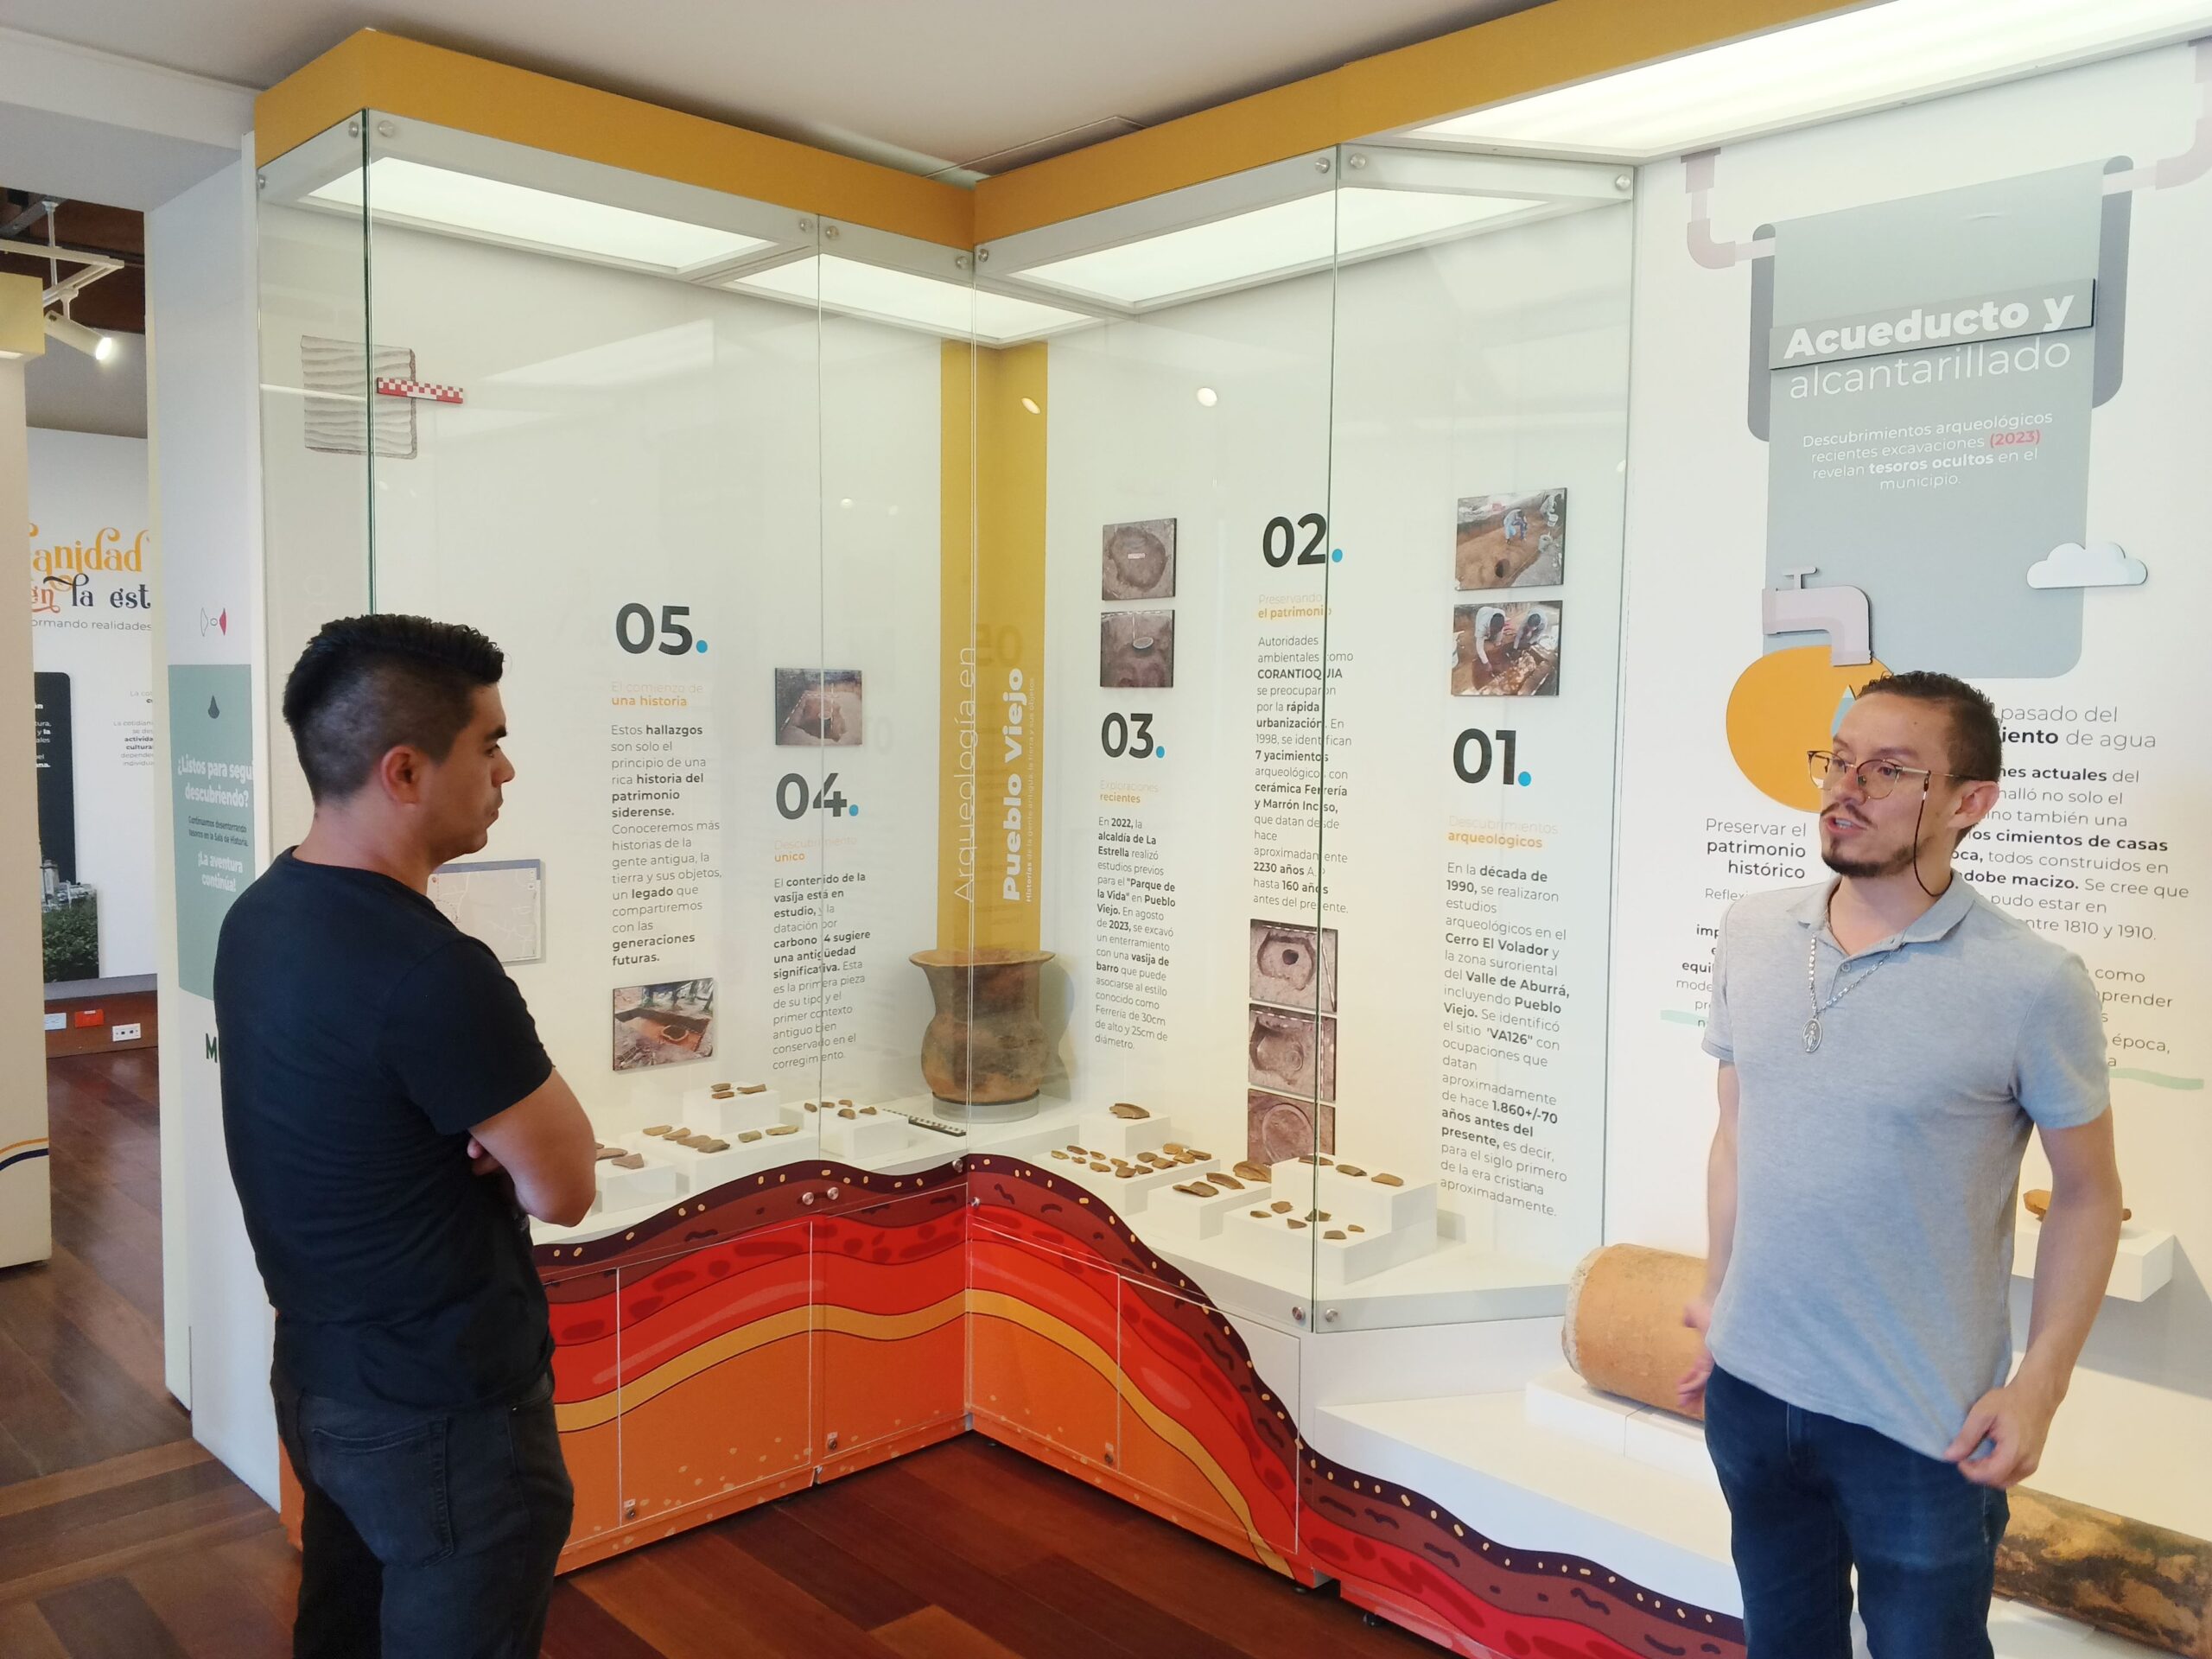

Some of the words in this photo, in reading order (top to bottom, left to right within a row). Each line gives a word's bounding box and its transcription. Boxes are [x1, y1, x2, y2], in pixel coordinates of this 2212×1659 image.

[1784, 305, 2029, 360] Acueducto
[2043, 294, 2075, 332] y
[1789, 336, 2071, 399] alcantarillado
[1803, 425, 1931, 448] Descubrimientos
[1936, 412, 2053, 435] arqueológicos
[1812, 448, 1878, 463] recientes
[1882, 436, 1984, 456] excavaciones
[1990, 429, 2040, 448] (2023)
[1814, 464, 1865, 479] revelan
[1869, 460, 1928, 474] tesoros
[1933, 453, 1994, 468] ocultos
[1999, 450, 2018, 463] en
[2024, 448, 2037, 460] el
[1880, 474, 1961, 490] municipio.
[1258, 636, 1319, 646] Autoridades
[1258, 652, 1319, 663] ambientales
[640, 696, 687, 706] historia
[1257, 702, 1273, 713] por
[1276, 702, 1283, 711] la
[1287, 701, 1319, 714] rápida
[1003, 668, 1027, 763] Viejo
[2000, 705, 2077, 723] pasado
[2084, 707, 2118, 722] del
[612, 725, 643, 734] Estos
[646, 725, 702, 737] hallazgos
[2066, 730, 2093, 746] de
[2100, 734, 2156, 750] agua
[1255, 750, 1261, 760] 7
[208, 762, 227, 779] para
[613, 775, 632, 785] rica
[637, 773, 682, 784] historia
[686, 773, 703, 783] del
[2031, 768, 2107, 781] actuales
[2113, 770, 2139, 782] del
[185, 783, 248, 807] descubriendo?
[612, 789, 680, 804] patrimonio
[1255, 783, 1301, 793] cerámica
[1100, 792, 1141, 804] recientes
[1255, 800, 1260, 810] y
[1263, 798, 1299, 810] Marrón
[2043, 791, 2063, 802] no
[2069, 791, 2102, 804] solo
[2108, 792, 2122, 804] el
[612, 808, 674, 817] siderense.
[2017, 810, 2088, 824] también
[2095, 815, 2127, 827] una
[612, 823, 693, 834] Conoceremos
[697, 821, 720, 830] más
[1099, 817, 1109, 826] En
[1111, 817, 1133, 829] 2022,
[1135, 819, 1141, 829] la
[1706, 818, 1786, 836] Preservar
[1792, 823, 1806, 836] el
[224, 834, 229, 843] de
[1003, 773, 1021, 900] Pueblo
[1098, 831, 1130, 842] alcaldía
[1134, 834, 1144, 843] de
[1147, 836, 1156, 845] La
[1448, 831, 1542, 849] arqueológicos
[1997, 830, 2082, 846] cimientos
[2088, 836, 2110, 848] de
[2117, 838, 2168, 851] casas
[1098, 846, 1128, 857] Estrella
[1132, 850, 1159, 860] realizó
[1707, 840, 1805, 857] patrimonio
[210, 855, 243, 873] aventura
[1254, 862, 1276, 873] 2230
[1280, 865, 1304, 875] años
[1728, 860, 1805, 879] histórico
[1989, 851, 2033, 865] todos
[2039, 855, 2140, 872] construidos
[2146, 861, 2168, 874] en
[1448, 862, 1462, 874] En
[1467, 864, 1476, 874] la
[1480, 865, 1527, 880] década
[1531, 871, 1548, 882] de
[1098, 876, 1116, 885] para
[1164, 882, 1175, 892] de
[1446, 880, 1477, 894] 1990,
[1481, 885, 1494, 894] se
[1498, 887, 1559, 902] realizaron
[1960, 870, 2006, 884] dobe
[2012, 875, 2079, 890] macizo.
[2085, 879, 2105, 892] Se
[2111, 881, 2148, 895] cree
[2154, 885, 2190, 899] que
[774, 892, 804, 903] vasija
[1097, 889, 1104, 898] la
[1145, 895, 1176, 906] Pueblo
[2039, 899, 2081, 912] estar
[2086, 901, 2107, 912] en
[774, 906, 816, 918] estudio,
[774, 921, 817, 933] datación
[2064, 919, 2098, 935] 1810
[2104, 926, 2113, 939] y
[2119, 925, 2156, 940] 1910.
[613, 934, 695, 951] generaciones
[1446, 933, 1478, 946] Cerro
[1484, 938, 1494, 949] El
[1498, 939, 1548, 957] Volador
[1552, 949, 1560, 960] y
[613, 954, 659, 965] futuras.
[1445, 968, 1462, 980] del
[1465, 970, 1497, 985] Valle
[1500, 976, 1516, 988] de
[1521, 980, 1569, 998] Aburrá,
[2095, 969, 2145, 982] como
[1129, 1011, 1139, 1020] de
[1141, 1013, 1166, 1026] 30cm
[848, 1033, 855, 1042] el
[2113, 1033, 2170, 1054] época,
[1442, 1091, 1456, 1102] de
[1461, 1094, 1488, 1109] hace
[1442, 1109, 1471, 1122] años
[1475, 1116, 1509, 1131] antes
[1514, 1123, 1533, 1137] del
[1441, 1127, 1500, 1149] presente,
[1503, 1141, 1516, 1151] es
[1520, 1144, 1554, 1161] decir,
